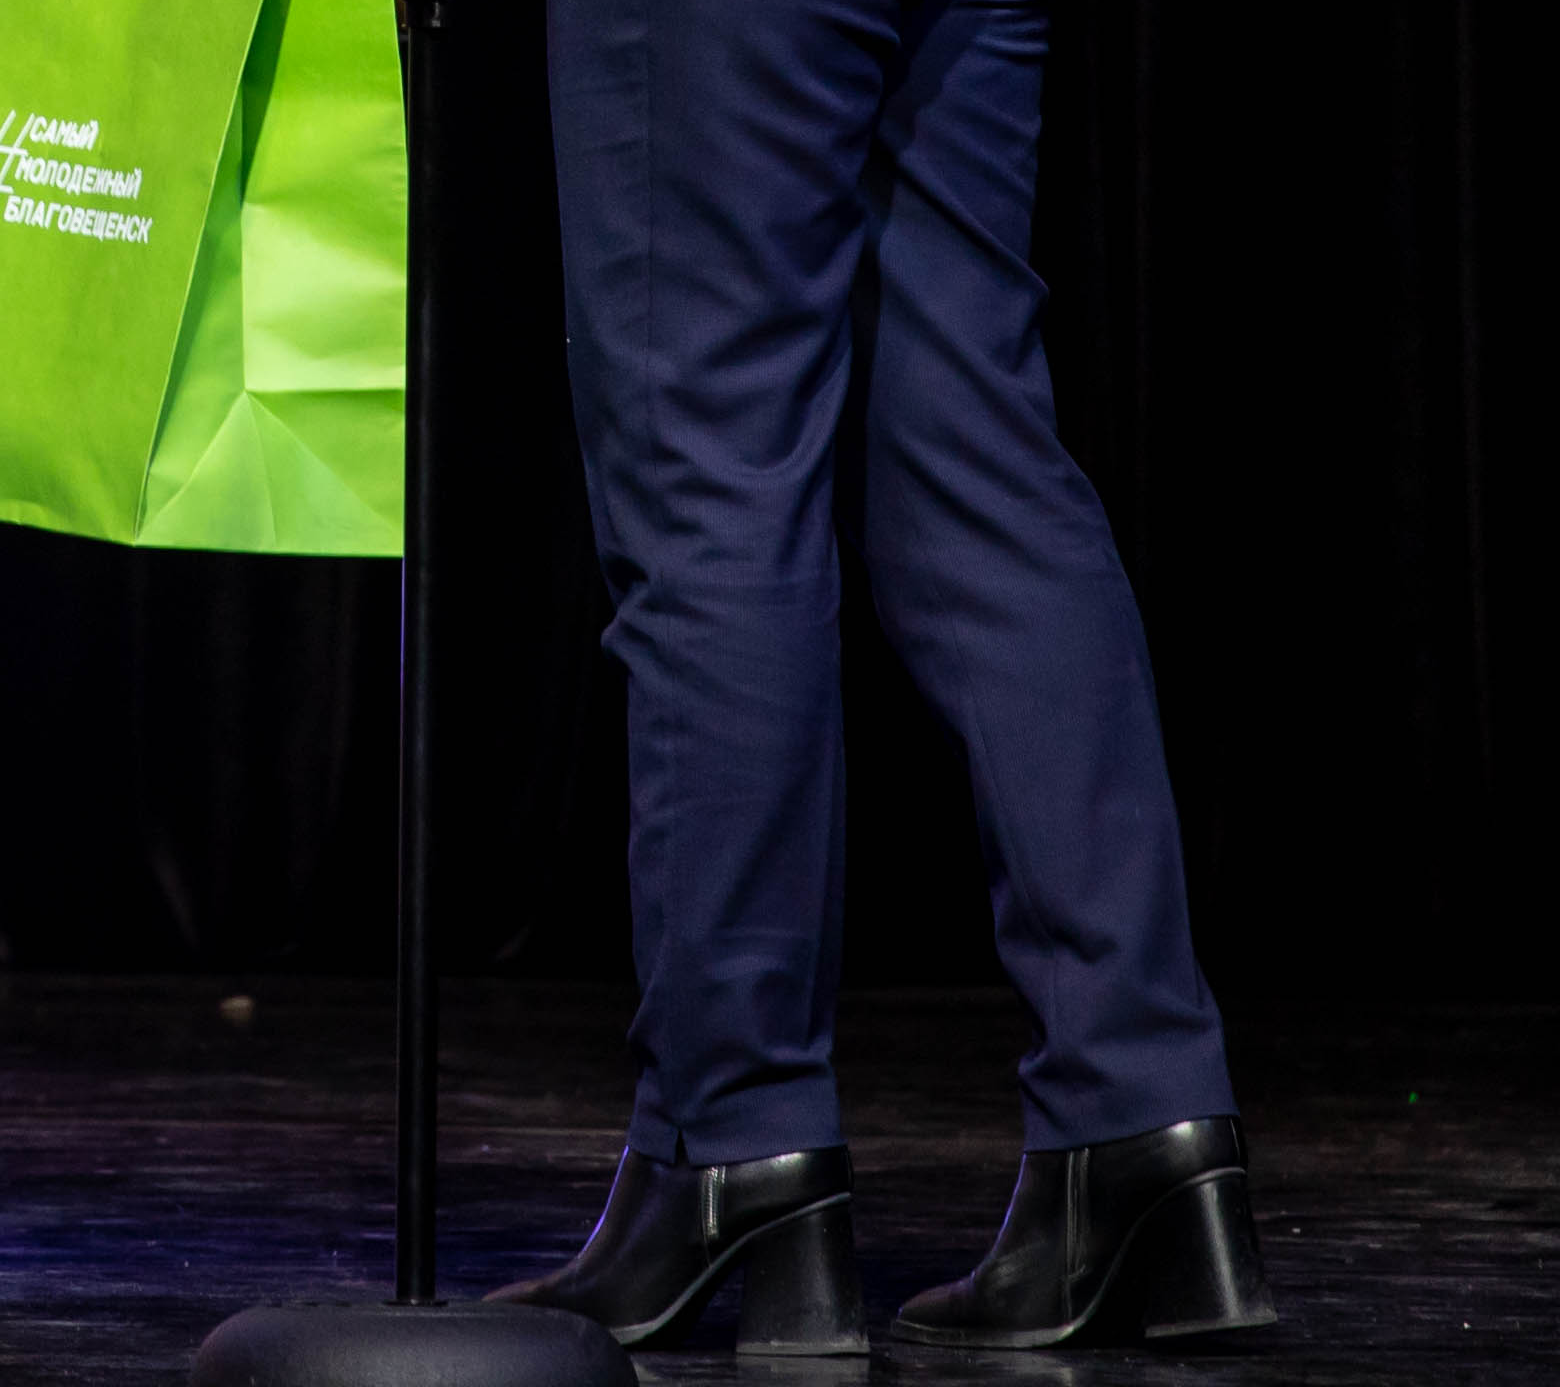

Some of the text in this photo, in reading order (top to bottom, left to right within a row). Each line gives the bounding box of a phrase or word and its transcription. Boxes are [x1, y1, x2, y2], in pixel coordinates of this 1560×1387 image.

[29, 116, 99, 151] САМЫЙ
[15, 154, 142, 201] МОЛОДЕЖНЫЙ
[4, 195, 153, 244] БЛАГОВЕЩЕНСК
